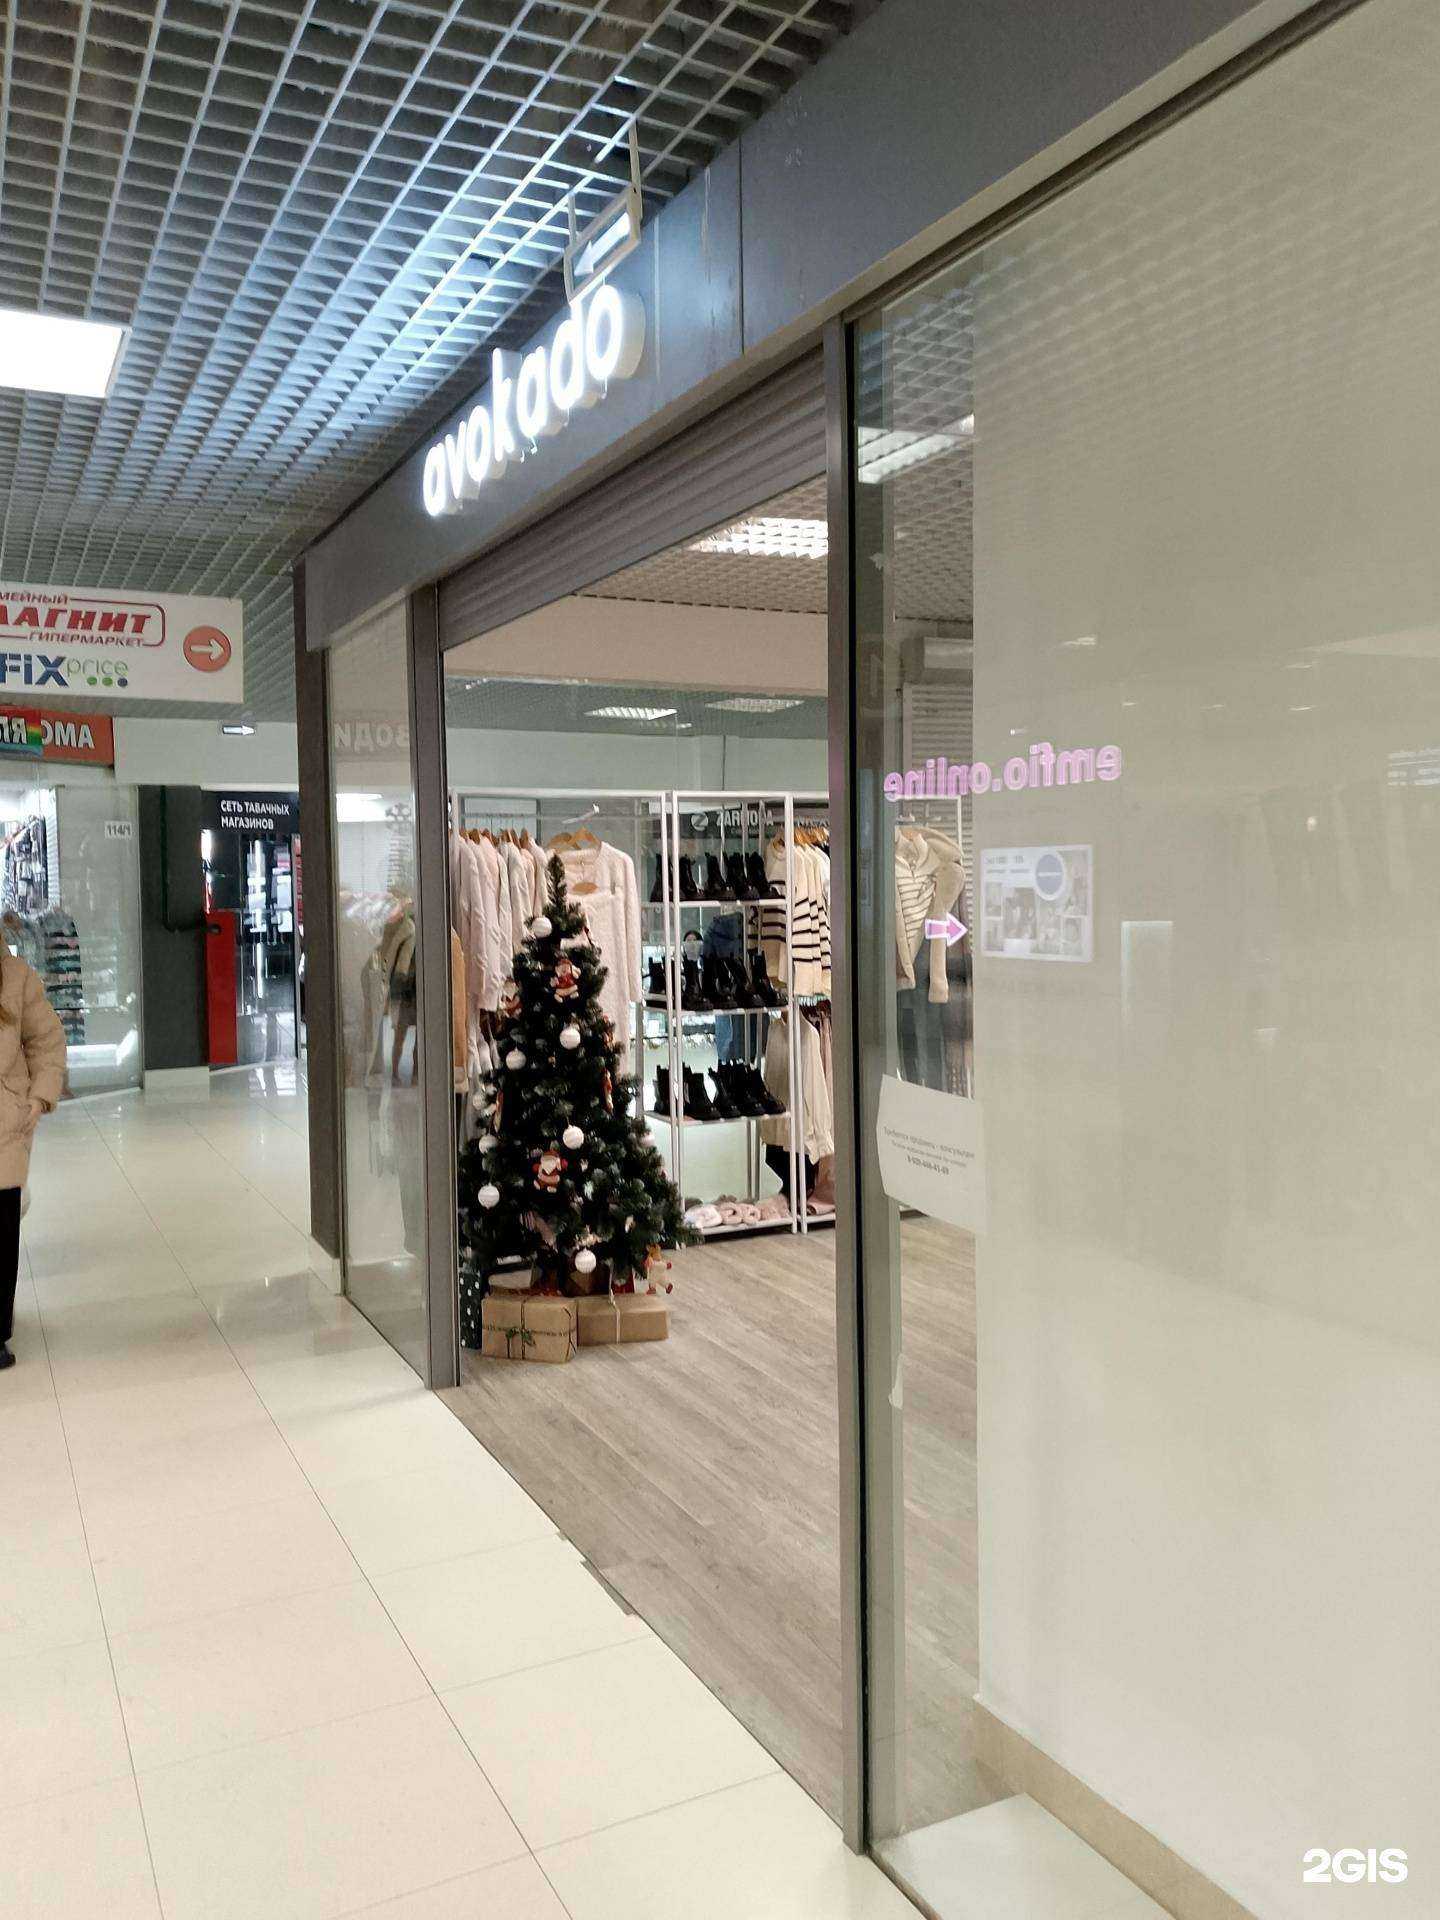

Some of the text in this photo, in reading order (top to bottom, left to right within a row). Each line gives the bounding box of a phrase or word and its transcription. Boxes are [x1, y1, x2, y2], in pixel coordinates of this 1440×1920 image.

[422, 284, 630, 517] avokado
[27, 631, 144, 647] ГИПЕРМАРКЕТ
[220, 799, 243, 813] СЕТЬ
[221, 815, 274, 830] МАГАЗИНОВ
